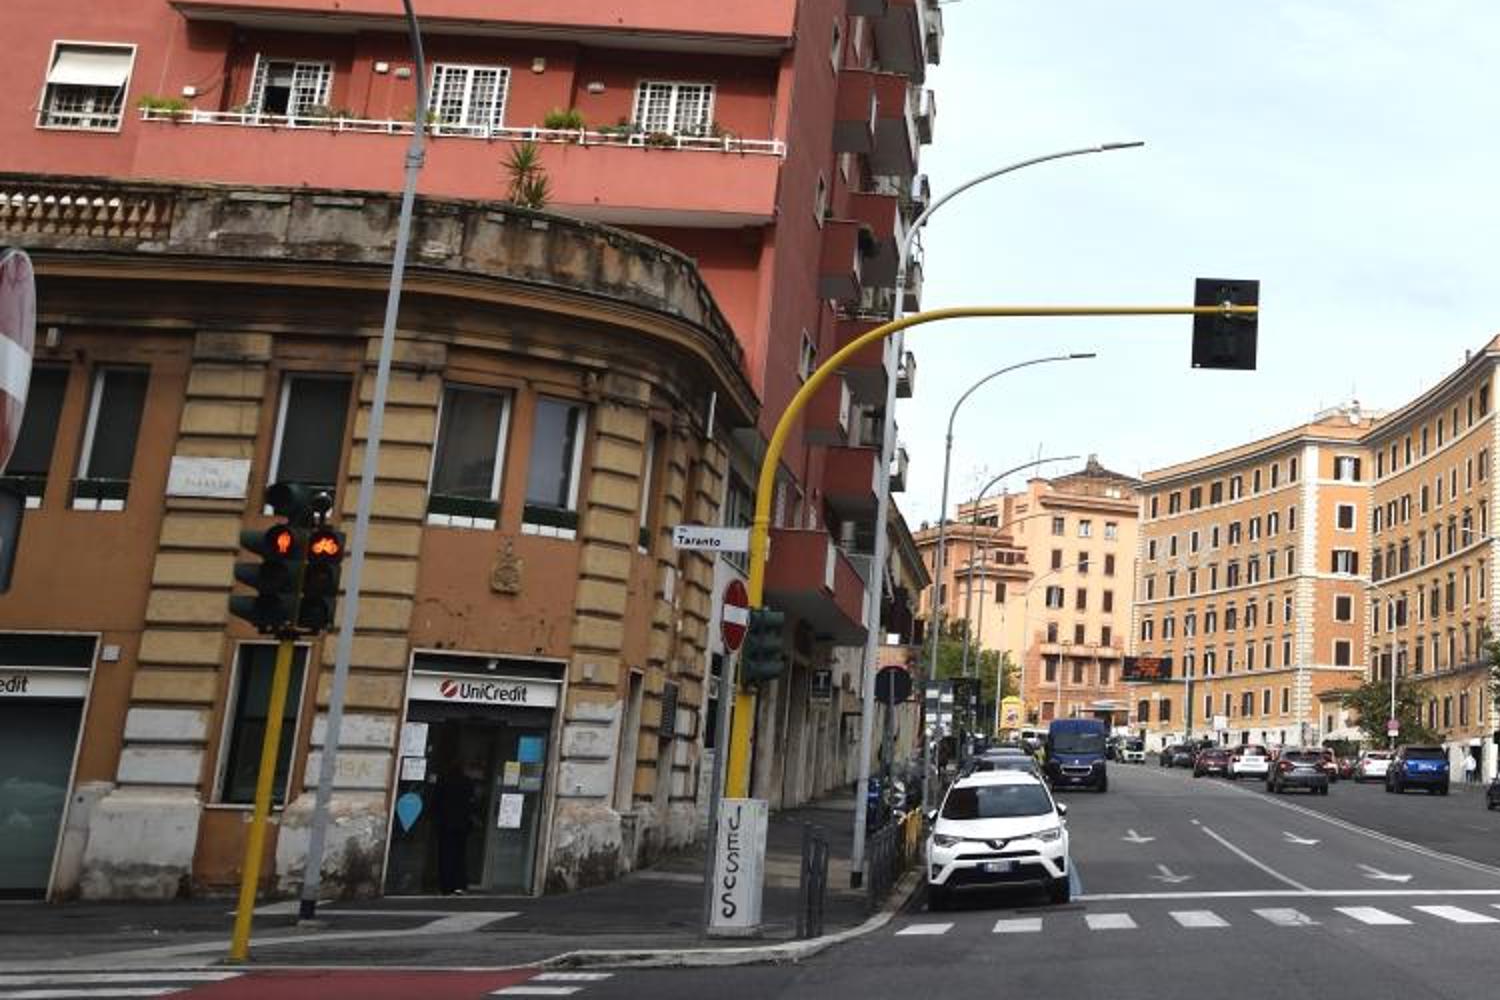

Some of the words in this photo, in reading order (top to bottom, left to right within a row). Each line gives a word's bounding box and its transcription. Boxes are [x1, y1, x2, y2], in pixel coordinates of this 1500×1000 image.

[677, 535, 721, 547] Taranto
[459, 682, 528, 703] UniCredit
[721, 805, 742, 919] JESUS
